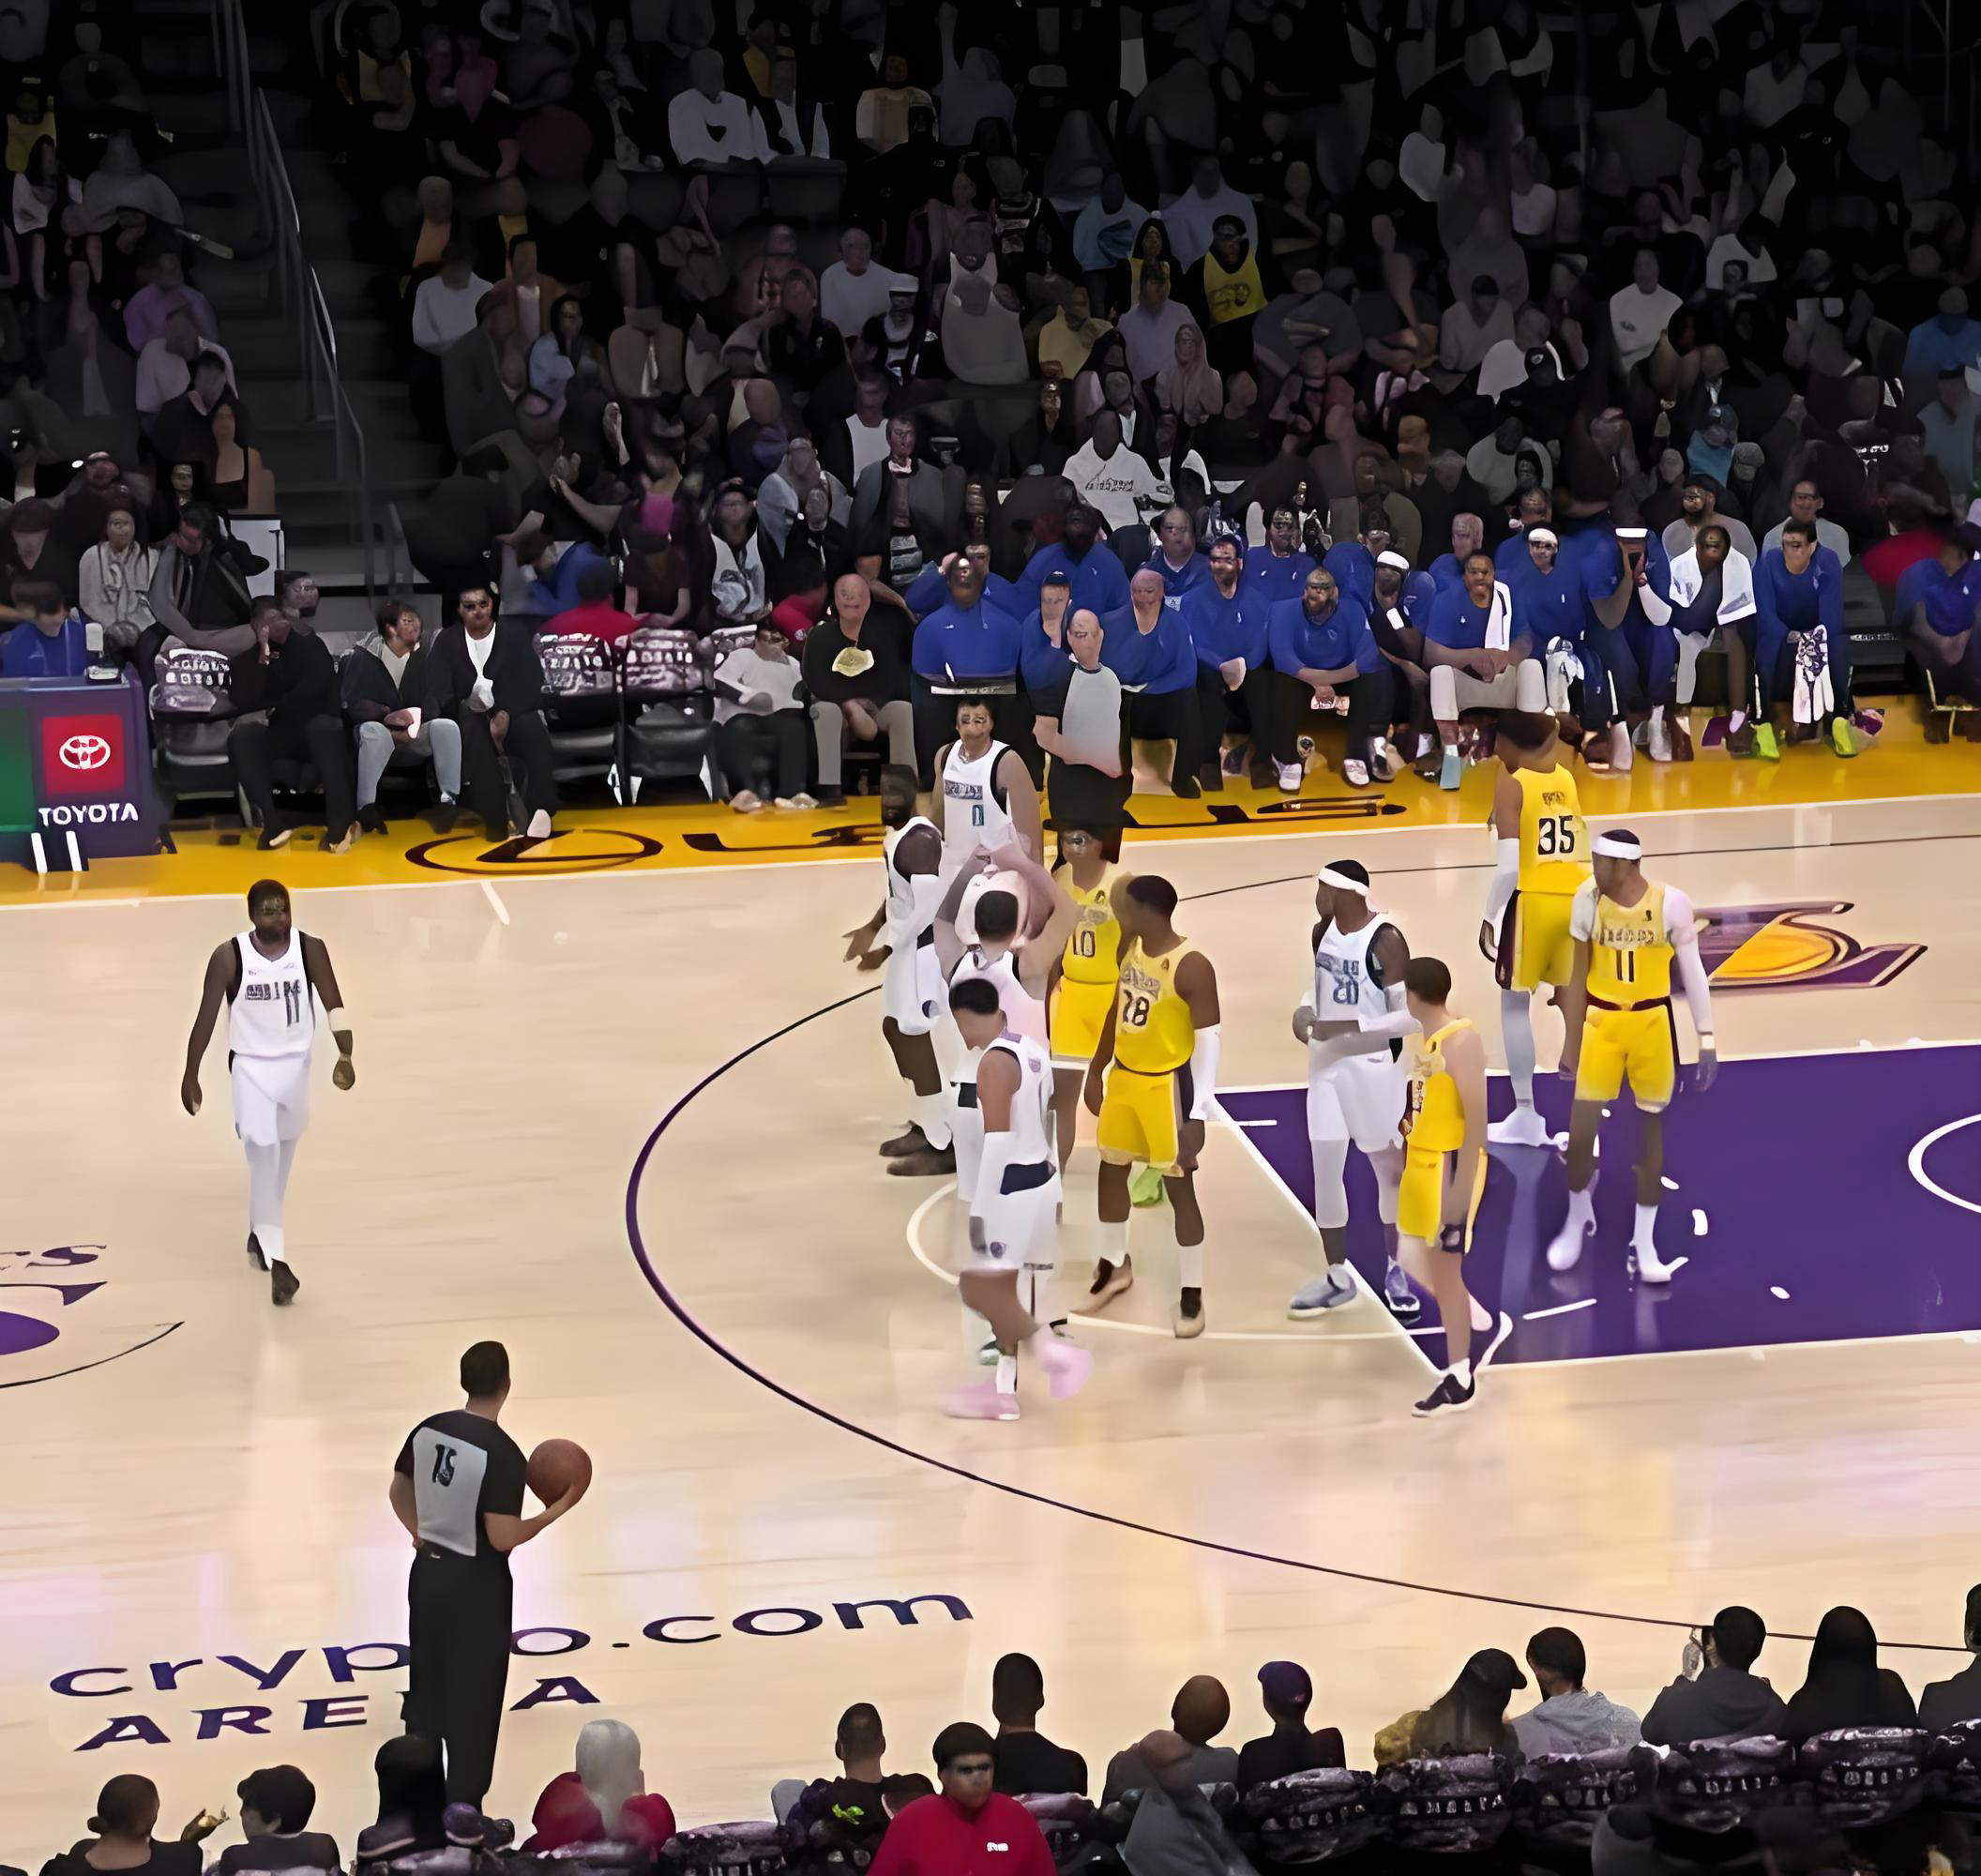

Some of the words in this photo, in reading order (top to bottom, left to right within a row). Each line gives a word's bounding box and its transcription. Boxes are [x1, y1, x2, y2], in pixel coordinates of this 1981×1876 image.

[38, 803, 139, 826] TOYOTA
[1537, 815, 1575, 855] 35
[1616, 948, 1634, 982] 11
[50, 1595, 974, 1696] crypo.com
[73, 1676, 600, 1751] AREA
